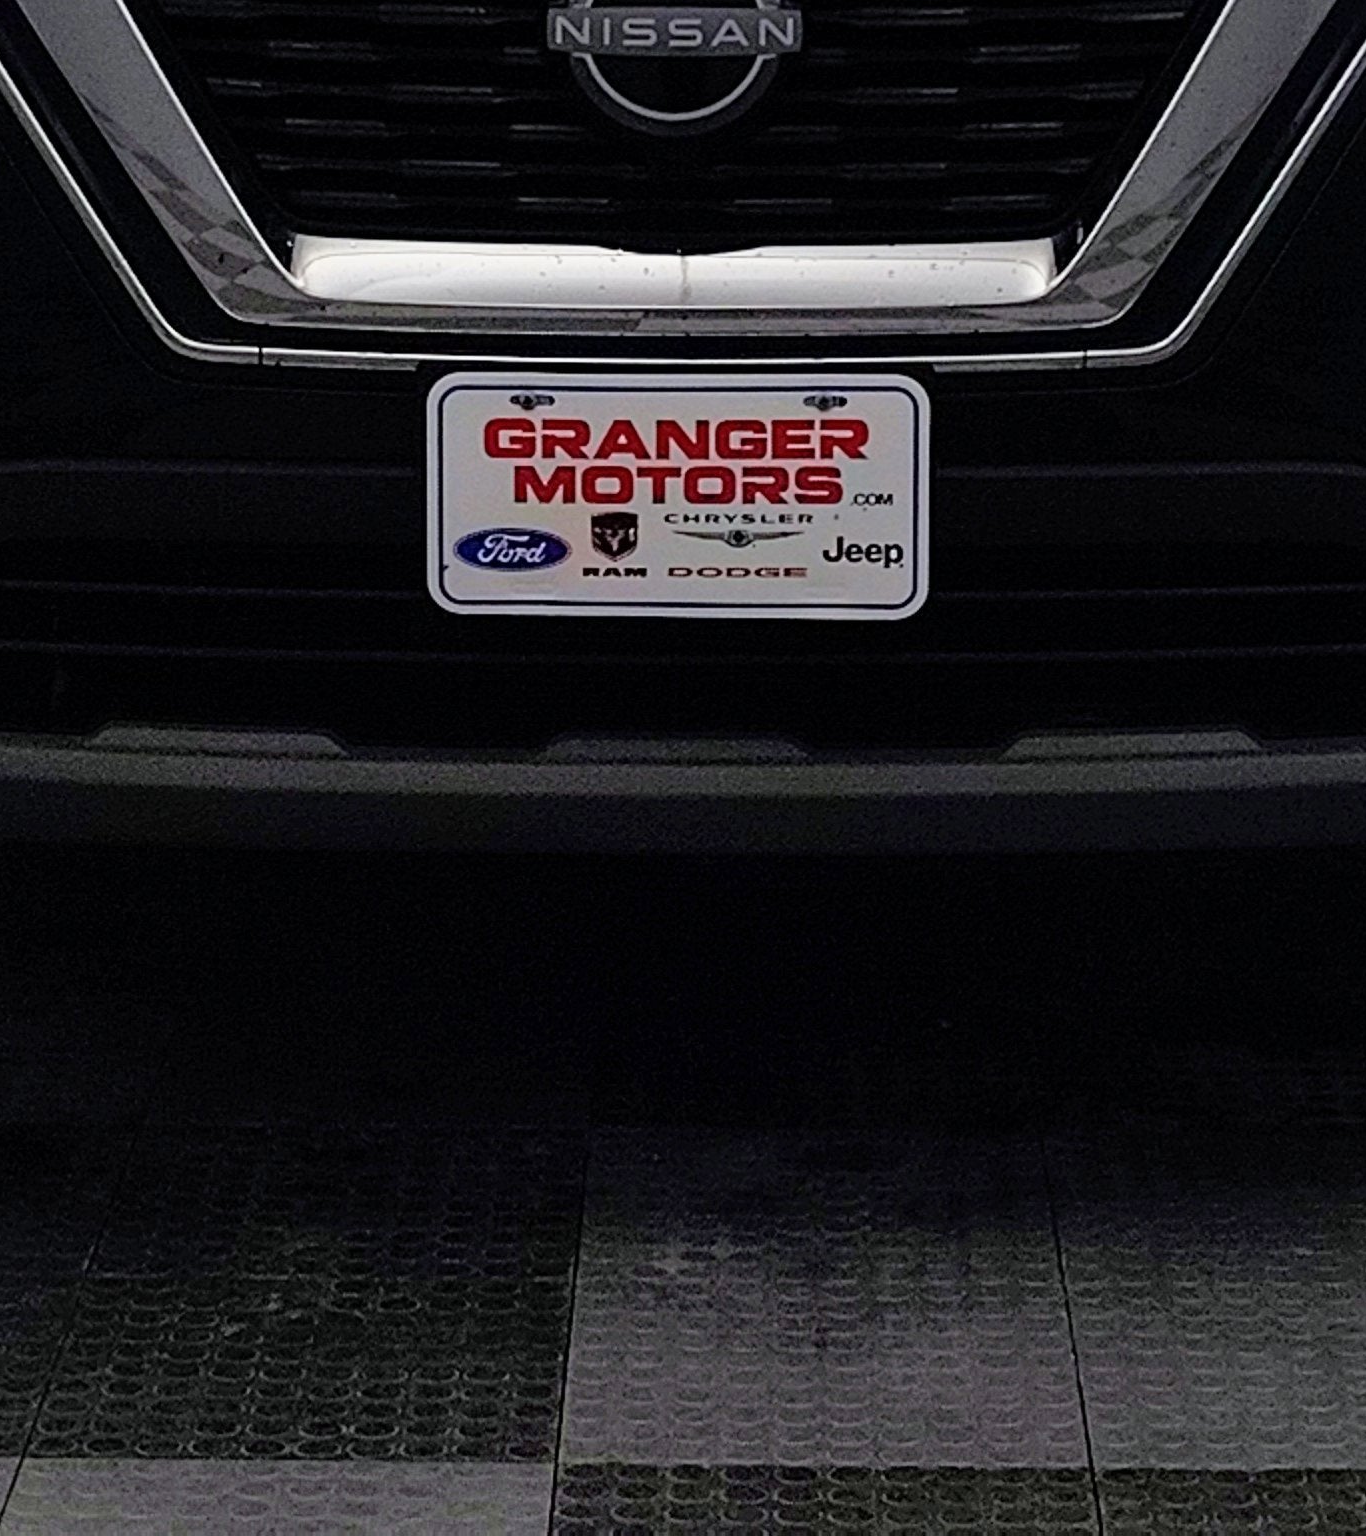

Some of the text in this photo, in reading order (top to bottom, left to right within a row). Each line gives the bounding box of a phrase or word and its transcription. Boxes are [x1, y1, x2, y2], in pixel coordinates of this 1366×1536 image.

[554, 16, 794, 47] NISSAN
[484, 417, 870, 460] GRANGER
[513, 466, 844, 504] MOTORS
[664, 513, 814, 524] CHRYSLER
[477, 534, 548, 565] Ford
[822, 536, 905, 568] Jeep
[582, 567, 648, 577] RAM
[667, 567, 808, 578] DODGE
